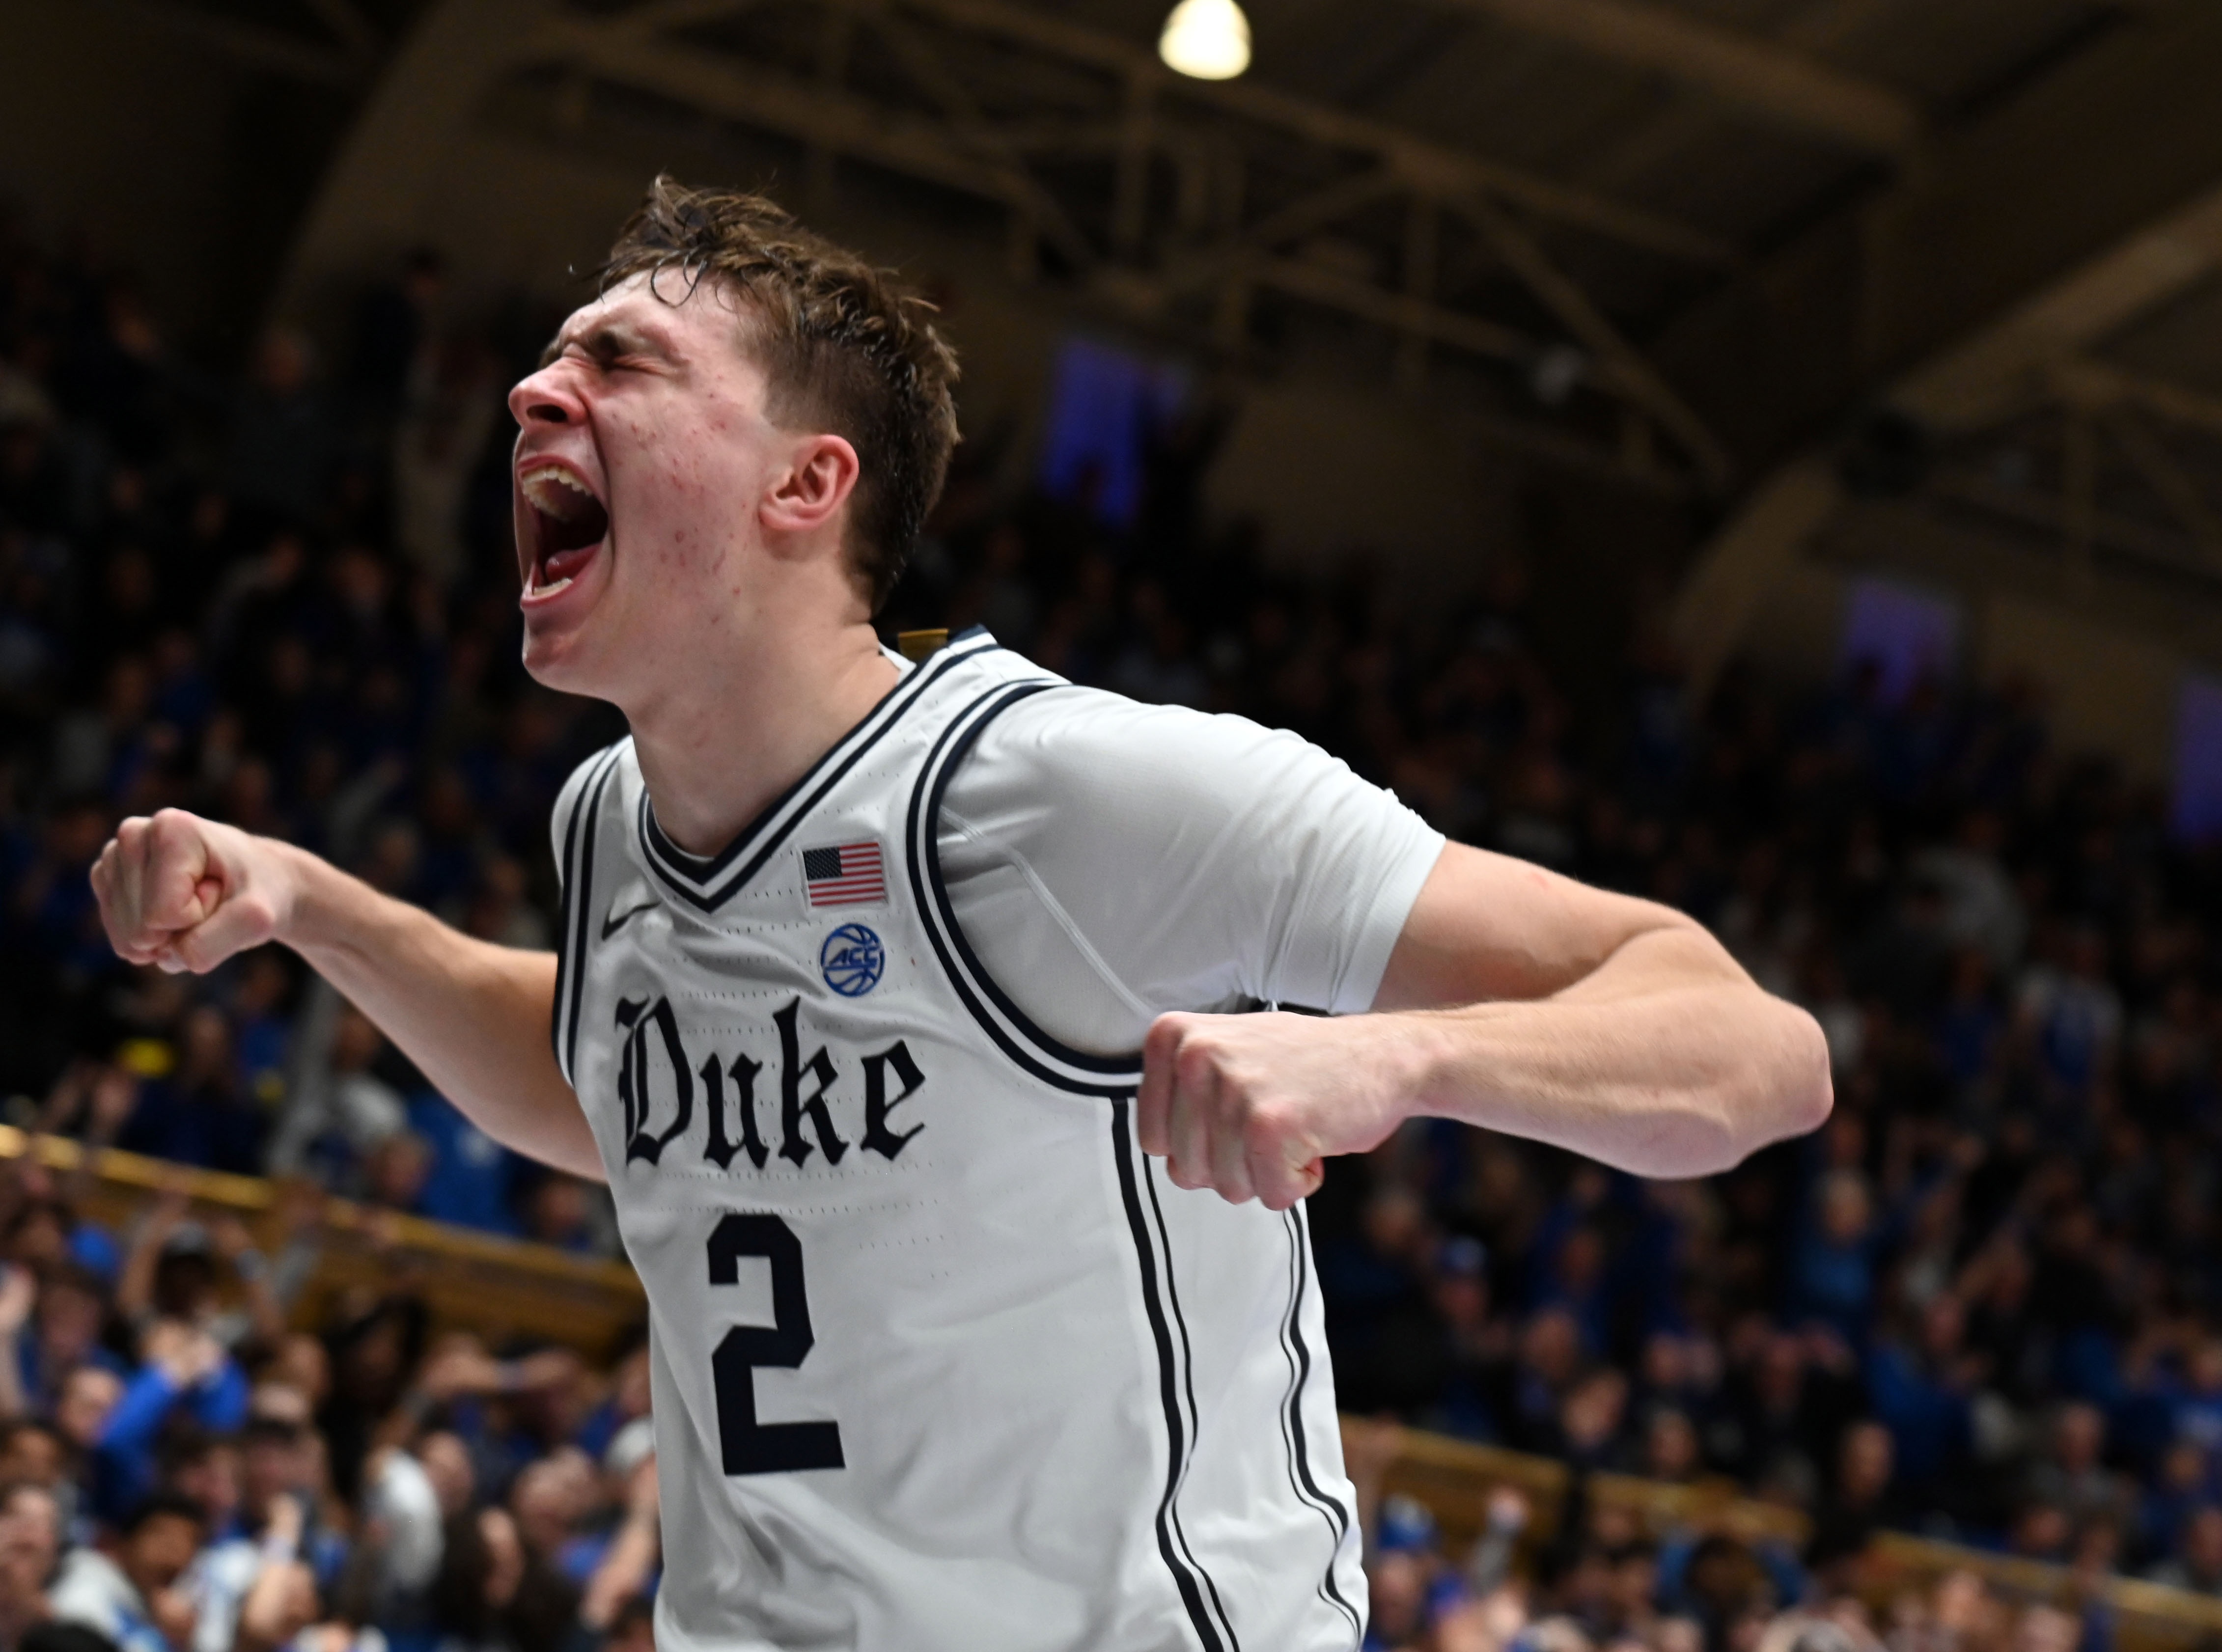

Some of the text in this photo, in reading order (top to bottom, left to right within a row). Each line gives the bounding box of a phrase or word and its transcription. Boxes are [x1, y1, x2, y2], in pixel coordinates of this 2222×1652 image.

[829, 946, 880, 968] ACC
[614, 994, 925, 1170] Duke
[706, 1212, 846, 1476] 2
